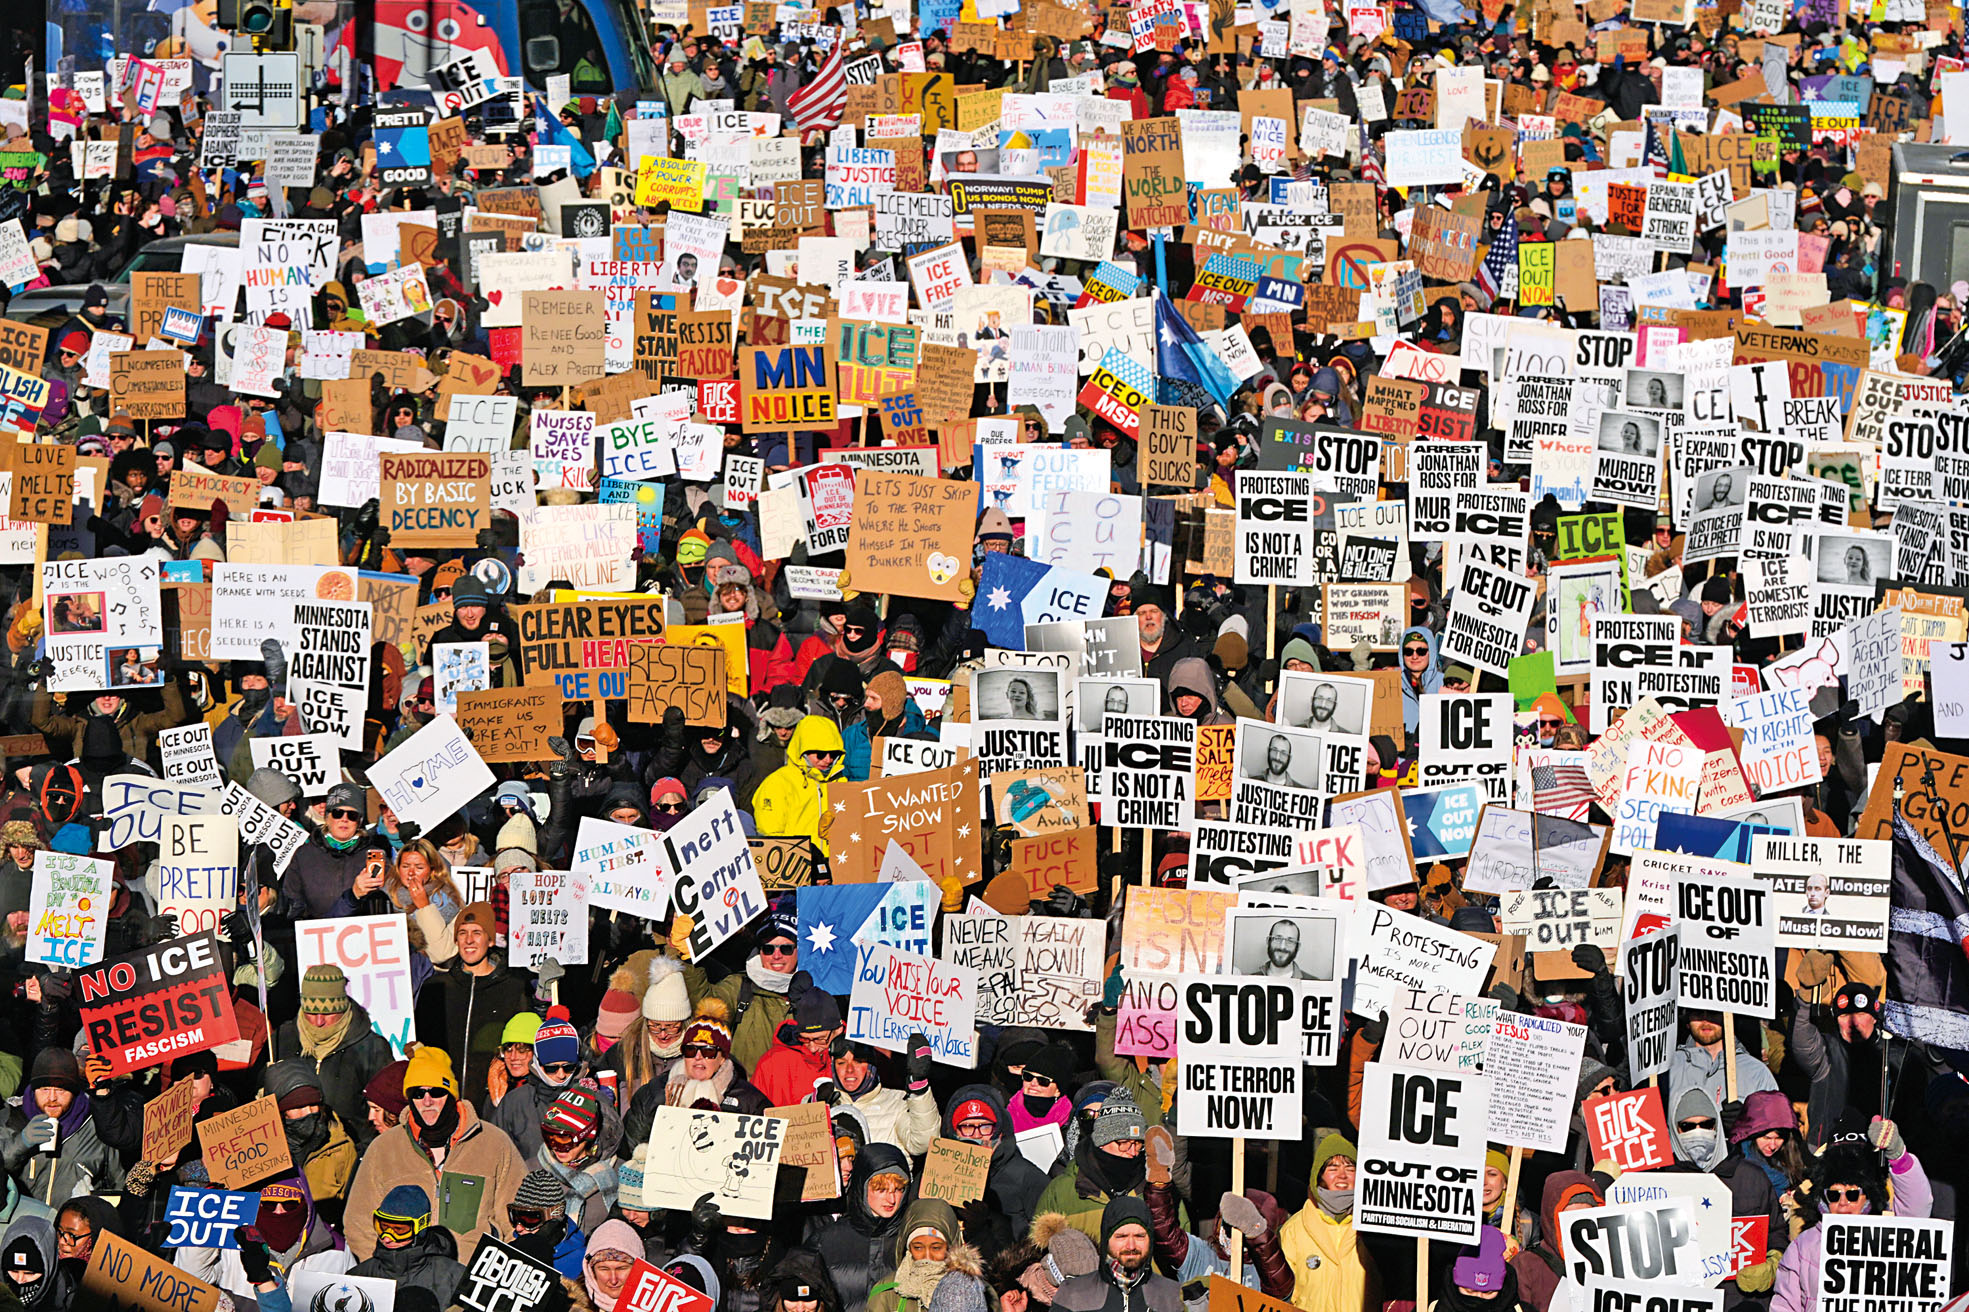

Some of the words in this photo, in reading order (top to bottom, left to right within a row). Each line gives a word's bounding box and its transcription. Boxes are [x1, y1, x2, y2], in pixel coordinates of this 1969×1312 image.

[710, 8, 740, 22] ICE
[1756, 3, 1780, 16] ICE
[958, 22, 987, 36] ICE
[1754, 16, 1780, 32] OUT
[956, 37, 991, 50] OUT!
[847, 57, 880, 83] STOP
[376, 112, 424, 126] PRETTI
[717, 114, 748, 129] ICE
[1124, 122, 1137, 135] WE
[1141, 121, 1159, 134] ARE
[1160, 119, 1178, 133] THE
[1257, 119, 1279, 131] MN
[1521, 117, 1551, 131] Vote
[1828, 118, 1857, 128] OUT
[206, 126, 240, 138] GOPHERS
[1253, 131, 1284, 143] NICE
[1418, 129, 1460, 145] LEGENDS
[1813, 129, 1847, 144] MSP
[204, 140, 238, 154] AGAINST
[1125, 132, 1180, 154] NORTH
[203, 155, 236, 168] ICE
[837, 146, 891, 164] LIBERTY
[383, 168, 427, 182] GOOD
[840, 166, 896, 183] JUSTICE
[1141, 166, 1163, 179] THE
[777, 183, 819, 199] ICE
[826, 184, 846, 206] FOR
[847, 186, 875, 205] ALL
[965, 186, 1013, 195] NORWAY!
[1016, 187, 1045, 196] DUMP
[1129, 176, 1183, 197] WORLD
[1650, 184, 1679, 195] EXPAND
[1680, 187, 1695, 197] THE
[983, 194, 1011, 204] BONDS
[1015, 196, 1047, 205] NOW!
[1148, 195, 1164, 207] IS
[1200, 193, 1238, 215] YEAH
[1649, 197, 1693, 215] GENERAL
[776, 206, 816, 226] OUT
[895, 218, 927, 234] UNDER
[1130, 205, 1188, 227] WATCHING
[1648, 218, 1689, 236] STRIKE!
[258, 243, 289, 263] NO
[1524, 248, 1549, 266] ICE
[1730, 250, 1760, 261] Pretti
[1765, 249, 1795, 261] Good
[247, 264, 310, 287] HUMAN
[590, 261, 665, 277] LIBERTY
[926, 260, 953, 282] ICE
[1522, 269, 1551, 287] OUT
[145, 277, 185, 298] FREE
[610, 275, 637, 287] AND
[269, 289, 289, 306] IS
[1521, 286, 1553, 304] NOW
[528, 296, 595, 316] REMEBER
[610, 300, 635, 311] FOR
[1, 328, 41, 351] ICE
[531, 328, 574, 342] RENEE
[679, 321, 733, 344] RESIST
[1736, 330, 1819, 355] VETERANS
[551, 344, 575, 355] AND
[840, 323, 915, 367] ICE
[1576, 334, 1633, 369] STOP
[529, 361, 559, 376] ALEX
[566, 362, 604, 377] PRETTI
[679, 350, 733, 377] FASCISM
[754, 346, 826, 390] MN
[1009, 361, 1045, 373] HUMAN
[1048, 361, 1077, 375] BEINGS
[882, 393, 915, 411] ICE
[1375, 386, 1413, 400] WHAT
[1903, 384, 1953, 404] JUSTICE
[703, 404, 736, 421] ICE
[1367, 395, 1417, 412] HAPPENED
[1785, 398, 1839, 425] BREAK
[1150, 409, 1186, 432] THIS
[545, 430, 590, 447] SAVE
[1796, 426, 1828, 441] THE
[23, 446, 65, 466] LOVE
[840, 452, 920, 467] MINNESOTA
[1316, 435, 1379, 472] STOP
[1414, 445, 1482, 454] ARREST
[383, 459, 489, 480] RADICALIZED
[1149, 459, 1192, 483] SUCKS
[1417, 455, 1479, 473] JONATHAN
[1600, 459, 1655, 483] MURDER
[179, 472, 252, 494] DEMOCRACY
[908, 480, 938, 499] JUST
[942, 485, 971, 501] SKIP
[1240, 476, 1309, 495] PROTESTING
[1334, 477, 1376, 494] TERROR
[1599, 478, 1657, 495] NOW!
[396, 483, 427, 505] BY
[432, 482, 476, 504] BASIC
[20, 499, 65, 520] ICE
[866, 502, 879, 515] TO
[889, 503, 909, 515] THE
[912, 503, 946, 516] PART
[392, 508, 480, 531] DECENCY
[868, 555, 912, 568] BUNKER
[1346, 544, 1368, 560] NO
[223, 572, 254, 584] HERE
[258, 572, 267, 583] IS
[271, 573, 288, 583] AN
[216, 587, 251, 598] ORANGE
[255, 587, 276, 598] WITH
[280, 588, 306, 598] SEEDS
[294, 603, 369, 630] MINNESOTA
[522, 606, 592, 643] CLEAR
[300, 626, 361, 653] STANDS
[49, 643, 104, 663] JUSTICE
[524, 642, 578, 675] FULL
[291, 652, 368, 683] AGAINST
[629, 644, 725, 686] RESIST
[463, 695, 546, 712] IMMIGRANTS
[462, 714, 504, 728] MAKE
[516, 711, 534, 721] US
[1440, 698, 1493, 750] ICE
[1104, 717, 1195, 743] PROTESTING
[978, 729, 1061, 757] JUSTICE
[1105, 741, 1193, 772] ICE
[1117, 799, 1180, 827] CRIME!
[171, 823, 209, 857] BE
[1024, 837, 1081, 865] FUCK
[1837, 845, 1863, 865] THE
[161, 866, 237, 901] PRETTI
[534, 873, 567, 888] HOPE
[1830, 878, 1890, 895] Monger
[1677, 881, 1714, 922] ICE
[1718, 886, 1767, 928] OUT
[950, 918, 1009, 945] NEVER
[1706, 924, 1740, 940] OF
[79, 962, 137, 1002] NO
[146, 937, 216, 982] ICE
[1626, 933, 1680, 1004] STOP
[1679, 948, 1770, 981] MINNESOTA
[1679, 972, 1713, 1001] FOR
[1715, 976, 1769, 1008] GOOD!
[88, 983, 225, 1055] RESIST
[1185, 982, 1295, 1046] STOP
[124, 1028, 205, 1064] FASCISM
[1185, 1063, 1216, 1091] ICE
[1219, 1065, 1296, 1094] TERROR
[1207, 1094, 1274, 1131] NOW!
[1387, 1072, 1463, 1149] ICE
[1363, 1158, 1432, 1180] OUT
[170, 1190, 246, 1221] ICE
[1362, 1178, 1476, 1217] MINNESOTA
[1826, 1223, 1948, 1261] GENERAL
[1822, 1258, 1946, 1299] STRIKE:
